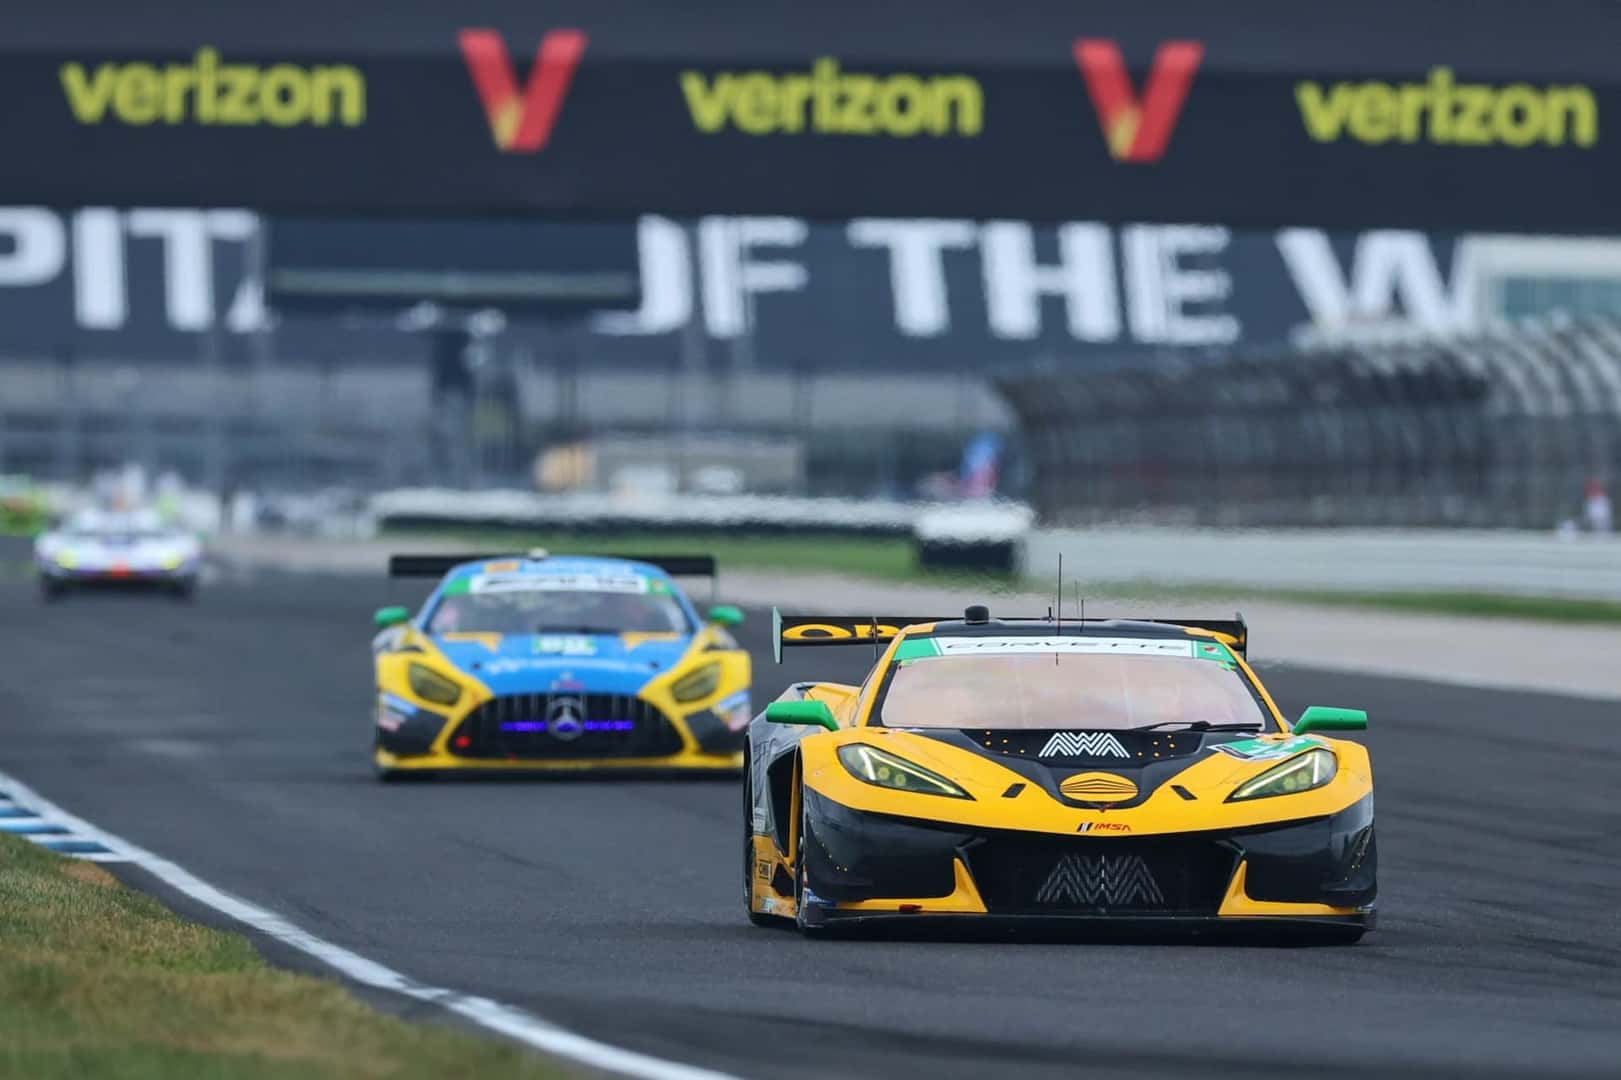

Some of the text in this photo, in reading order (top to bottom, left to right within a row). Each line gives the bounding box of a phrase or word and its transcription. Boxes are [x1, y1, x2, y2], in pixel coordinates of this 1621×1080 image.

[60, 47, 366, 127] verizon
[680, 57, 984, 136] verizon
[1296, 65, 1598, 147] verizon
[847, 218, 1239, 344] THE
[1094, 823, 1132, 832] IMSA
